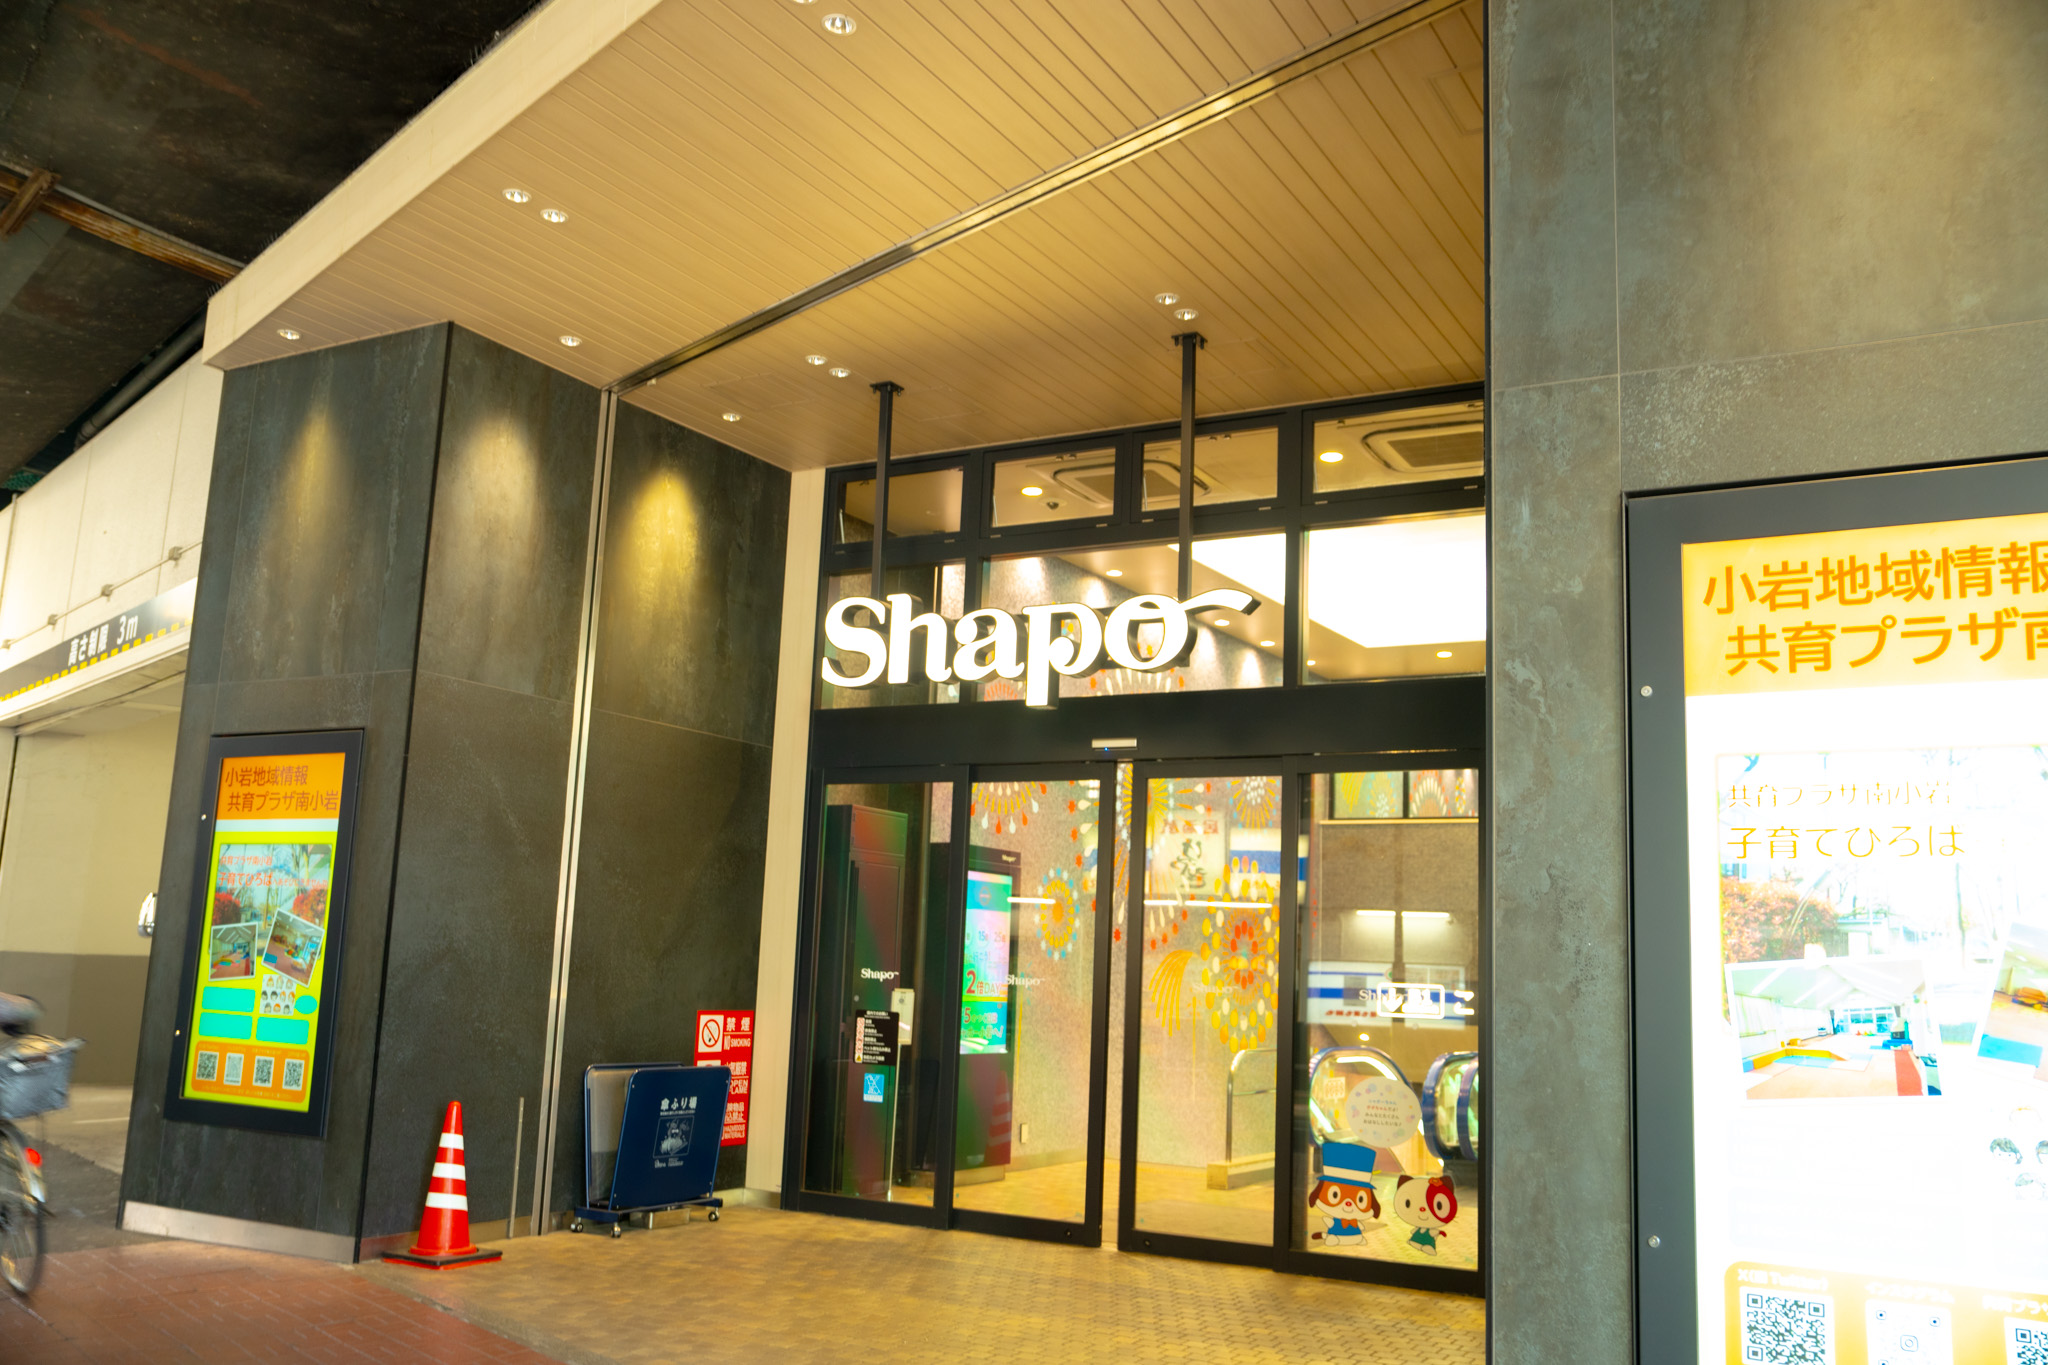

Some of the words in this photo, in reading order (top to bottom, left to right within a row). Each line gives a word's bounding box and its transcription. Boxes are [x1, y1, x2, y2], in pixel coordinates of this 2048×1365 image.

[1703, 541, 2048, 615] 小岩地域情報
[68, 623, 109, 666] 高さ制限
[117, 615, 138, 645] 3m
[822, 589, 1260, 708] Shapo
[225, 765, 309, 787] 小岩地域情報
[227, 789, 339, 812] 共育プラザ南小岩
[861, 968, 899, 982] Shapo
[730, 1038, 751, 1048] SMOKING
